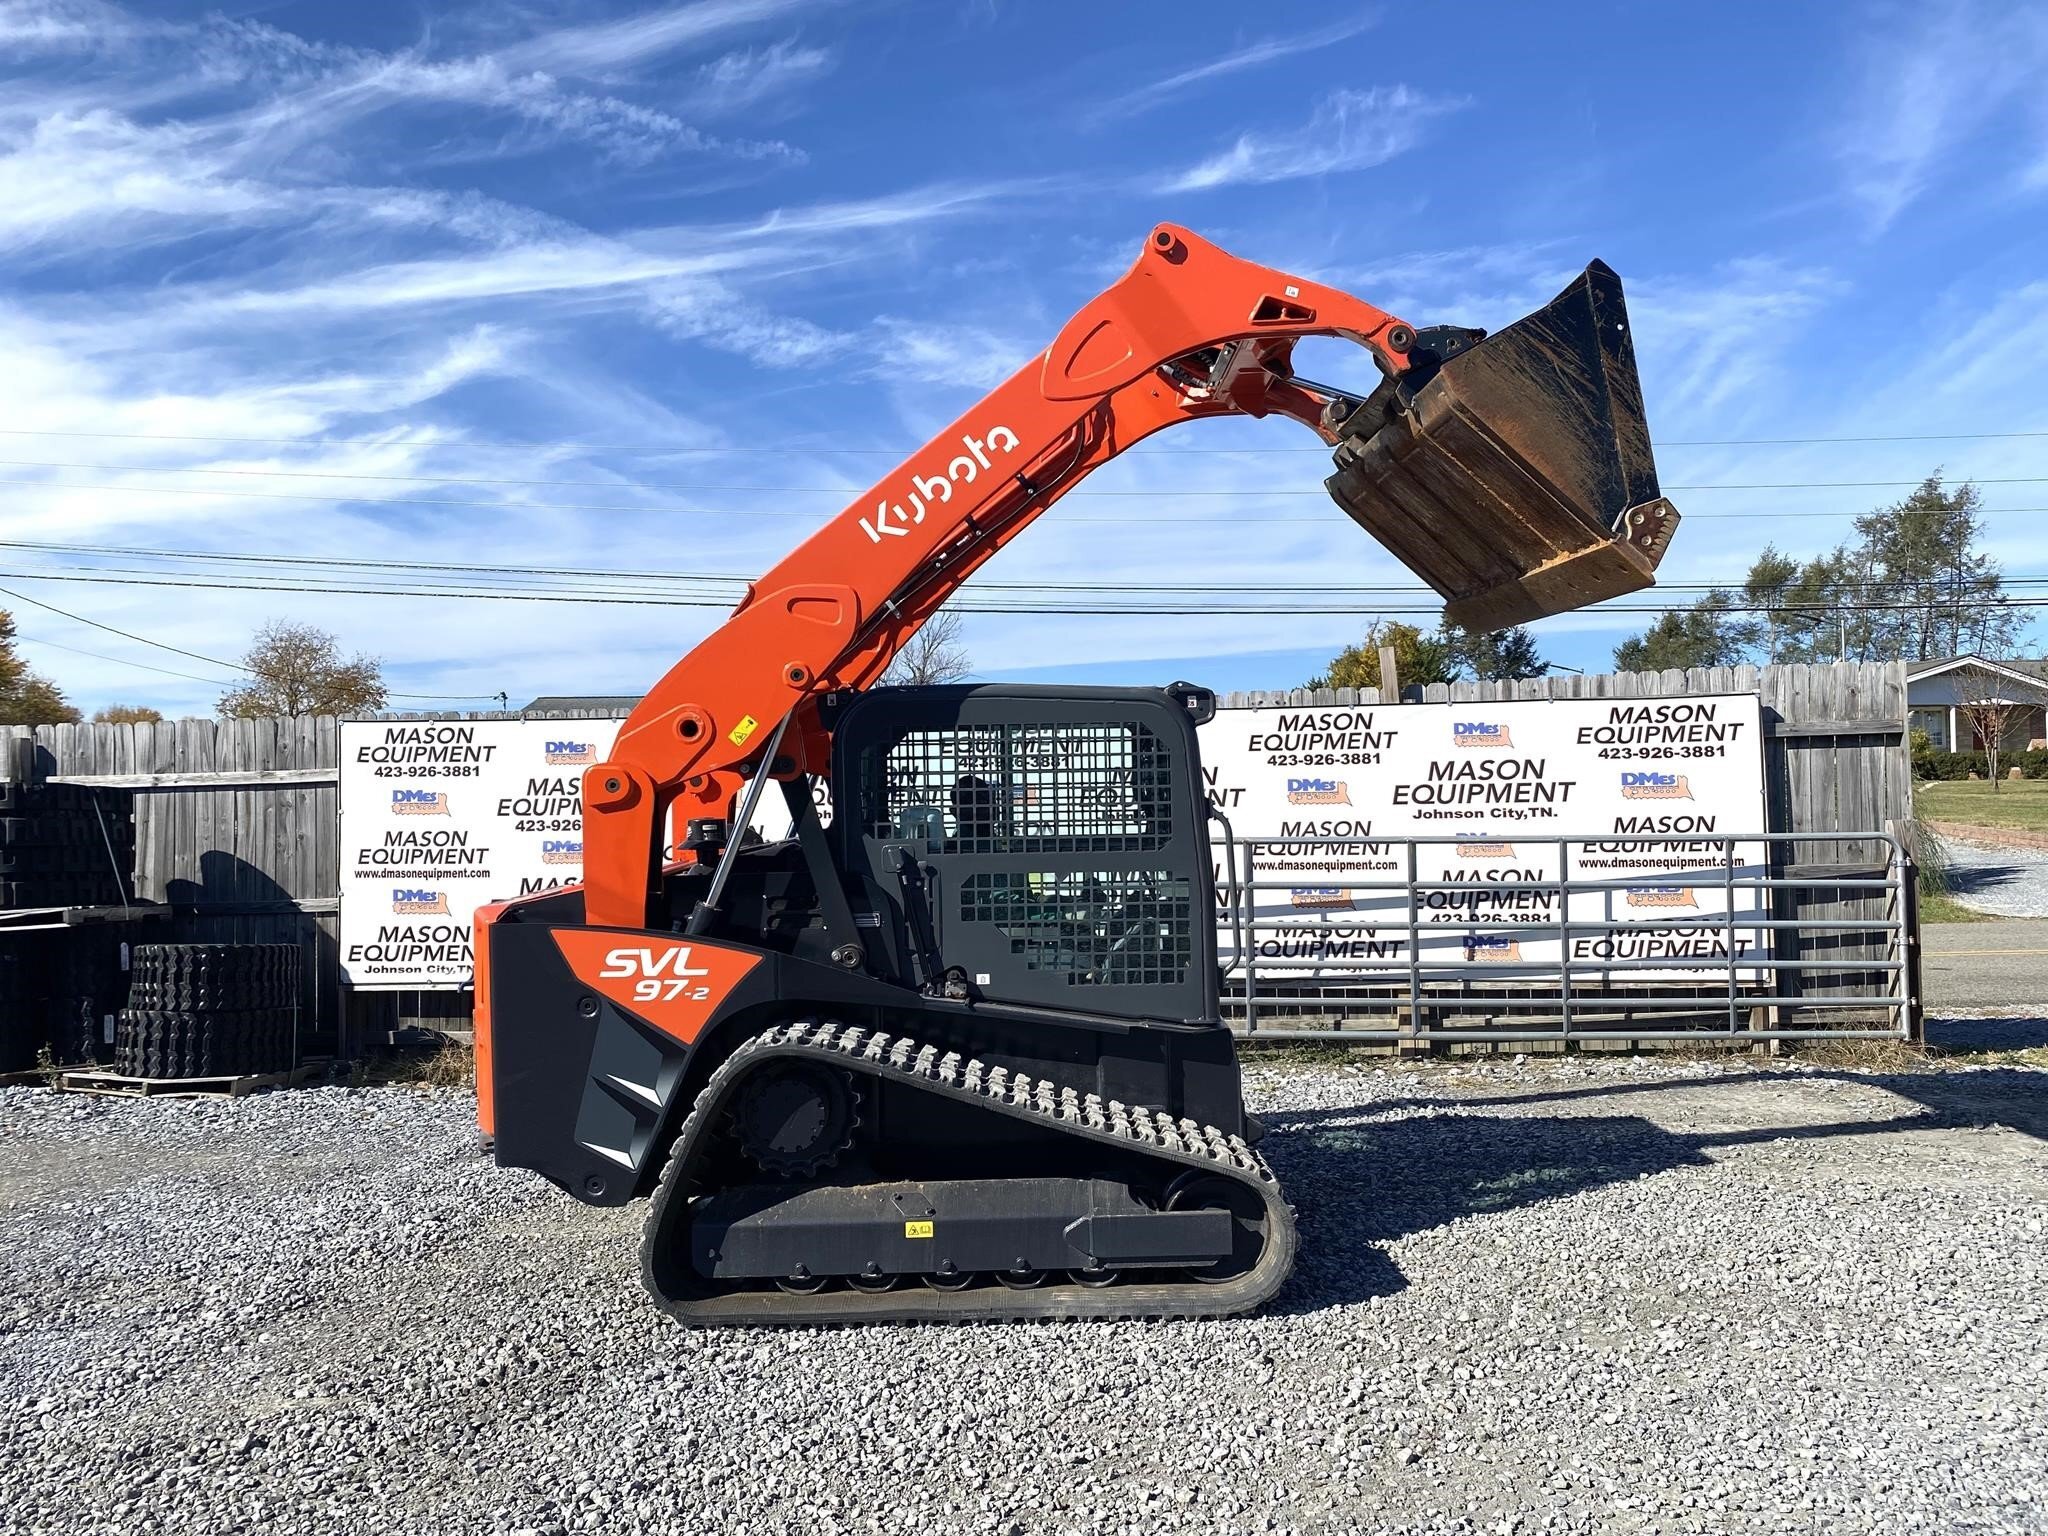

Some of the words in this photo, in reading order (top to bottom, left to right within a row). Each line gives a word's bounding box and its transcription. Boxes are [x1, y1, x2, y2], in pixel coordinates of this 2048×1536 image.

[858, 425, 1020, 544] Kubota
[1277, 712, 1374, 732] MASON
[1609, 703, 1717, 725] MASON
[385, 727, 474, 744] MASON
[1248, 731, 1398, 752] EQUIPMENT
[1576, 722, 1745, 745] EQUIPMENT
[356, 745, 496, 763] EQUIPMENT
[1267, 753, 1381, 766] 423-926-3881
[1597, 745, 1725, 759] 423-926-3881
[374, 765, 480, 777] 423-926-3881
[958, 756, 1069, 769] 423-6-3881
[1428, 758, 1546, 781] MASON
[1392, 781, 1577, 805] EQUIPMENT
[1412, 808, 1485, 820] Johnson
[1490, 806, 1558, 820] City,TN.
[1280, 820, 1371, 837] MASON
[1613, 815, 1716, 834] MASON
[384, 830, 468, 847] MASON
[358, 848, 489, 865] EQUIPMENT
[354, 867, 490, 881] www.dmasonequipment.com
[1442, 869, 1543, 882] MASON
[1431, 912, 1551, 923] 423-926-3881
[378, 926, 471, 943] MASON
[1574, 939, 1753, 959] EQUIPMENT
[364, 965, 422, 974] Johnson
[599, 947, 709, 978] SVL
[633, 979, 710, 1002] 97-2
